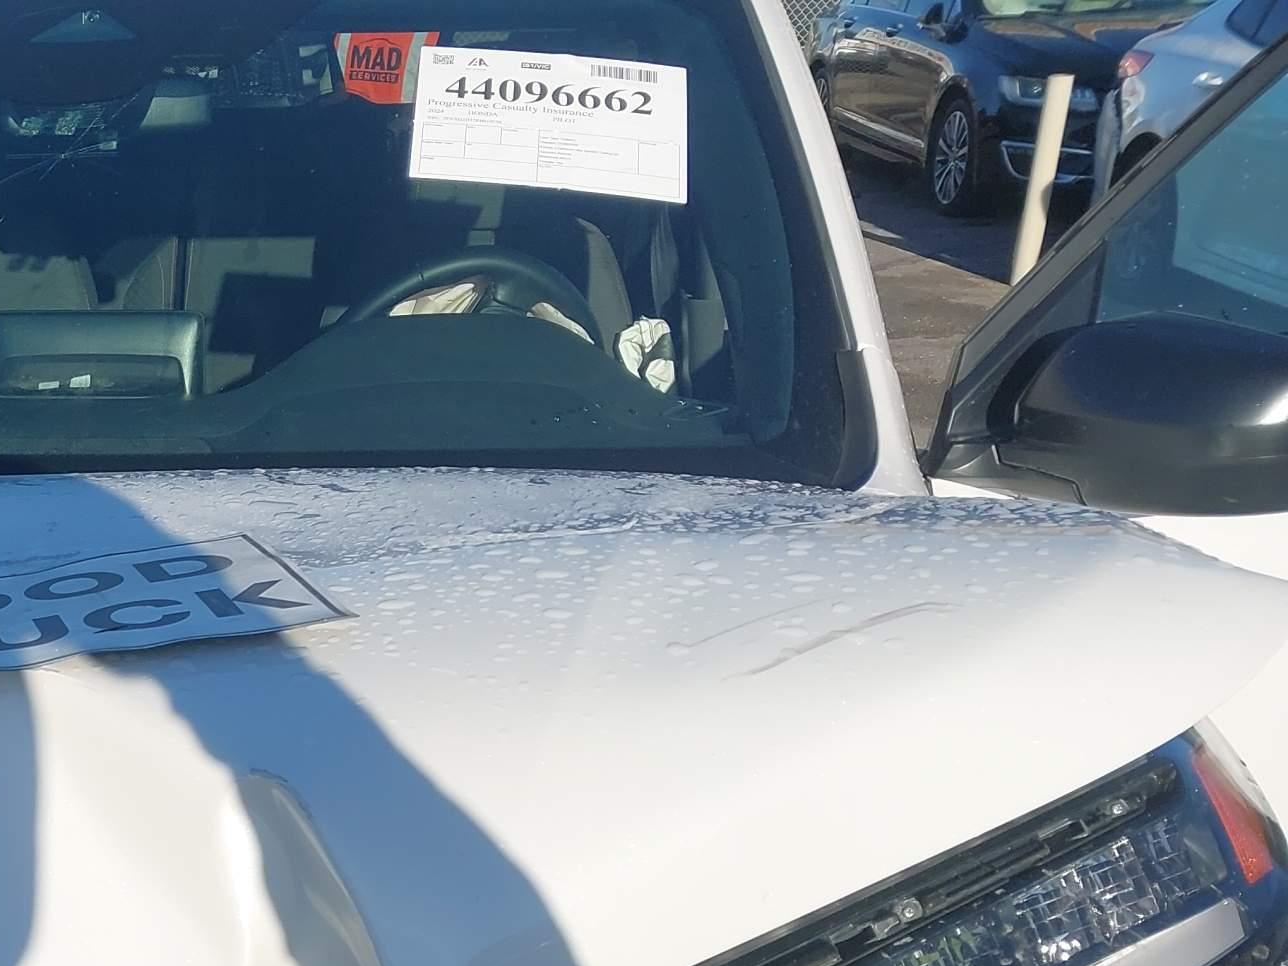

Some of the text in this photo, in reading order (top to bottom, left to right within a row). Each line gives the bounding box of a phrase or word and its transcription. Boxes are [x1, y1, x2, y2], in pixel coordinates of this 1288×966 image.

[350, 45, 402, 71] MAD
[427, 99, 594, 117] Progressive Casualty Insurance
[445, 77, 653, 115] 44096662
